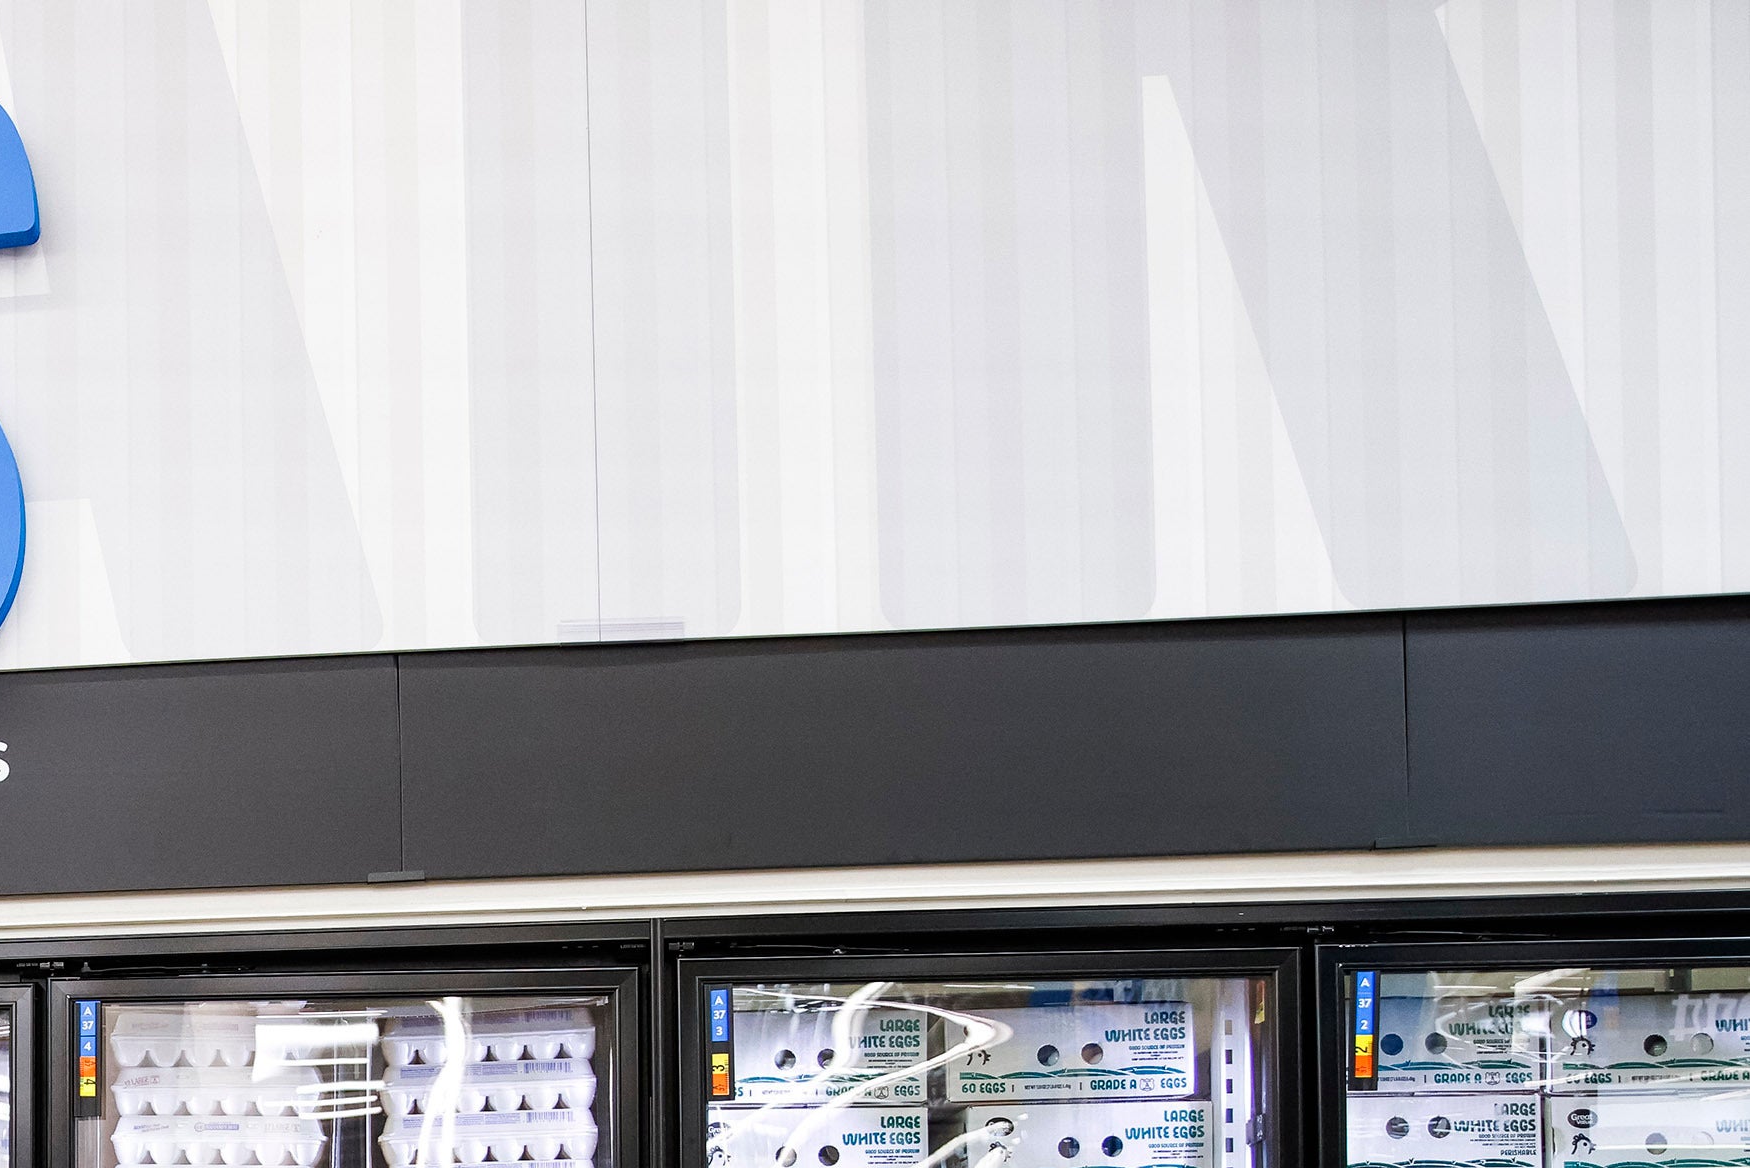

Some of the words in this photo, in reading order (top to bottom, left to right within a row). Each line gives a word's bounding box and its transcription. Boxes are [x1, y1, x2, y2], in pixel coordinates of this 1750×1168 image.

[1360, 978, 1370, 987] A
[714, 996, 723, 1005] A
[1358, 999, 1371, 1008] 37
[83, 1007, 93, 1016] A
[713, 1010, 725, 1020] 37
[1144, 1011, 1185, 1024] LARGE
[82, 1021, 94, 1030] 37
[880, 1019, 920, 1032] LARGE
[1360, 1020, 1368, 1030] 2
[716, 1027, 723, 1036] 3
[1105, 1029, 1151, 1042] WHITE
[1154, 1027, 1186, 1041] EGGS
[83, 1042, 92, 1051] 4
[889, 1036, 920, 1048] EGGS
[1434, 1073, 1471, 1084] GRADE
[1474, 1073, 1482, 1083] A
[1506, 1072, 1533, 1083] EGGS
[1585, 1073, 1612, 1083] EGGS
[1701, 1071, 1739, 1081] GRADE
[961, 1083, 976, 1093] 60
[980, 1083, 1006, 1093] EGGS
[1090, 1079, 1126, 1091] GRADE
[1130, 1079, 1137, 1089] A
[1160, 1078, 1187, 1088] EGGS
[894, 1086, 920, 1096] EGGS
[1164, 1110, 1204, 1122] LARGE
[1570, 1113, 1592, 1122] Great
[880, 1116, 921, 1129] LARGE
[1454, 1120, 1499, 1132] WHITE
[1503, 1119, 1536, 1132] EGGS
[1126, 1126, 1169, 1140] WHITE
[1173, 1125, 1204, 1139] EGGS
[842, 1133, 886, 1146] WHITE
[889, 1132, 921, 1145] EGGS
